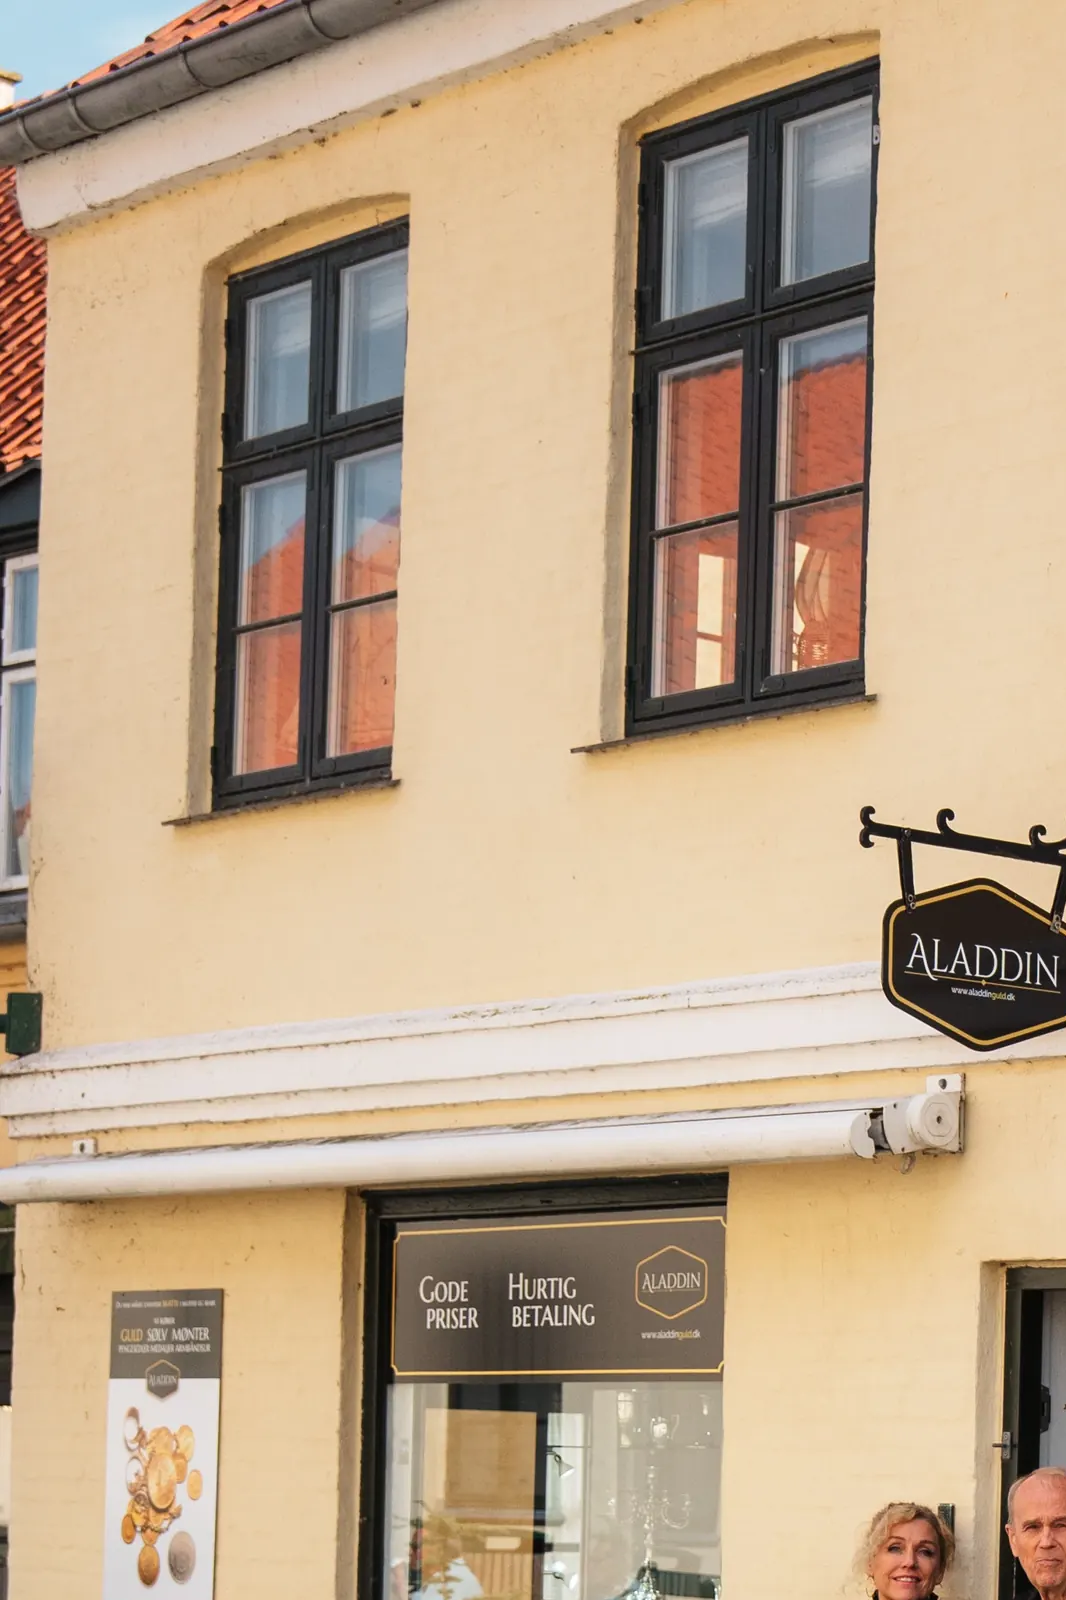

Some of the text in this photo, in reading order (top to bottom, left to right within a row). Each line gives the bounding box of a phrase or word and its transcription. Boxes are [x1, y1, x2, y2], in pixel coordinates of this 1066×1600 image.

[906, 933, 1060, 988] ALADDIN
[951, 986, 1016, 1001] www.aladdinguld.dk
[419, 1275, 469, 1304] GODE
[508, 1272, 576, 1301] HURTIG
[642, 1272, 701, 1294] ALADDIN
[426, 1307, 479, 1330] PRISER
[512, 1303, 596, 1328] BETALING
[121, 1327, 210, 1342] GULD SØLV MØNTER
